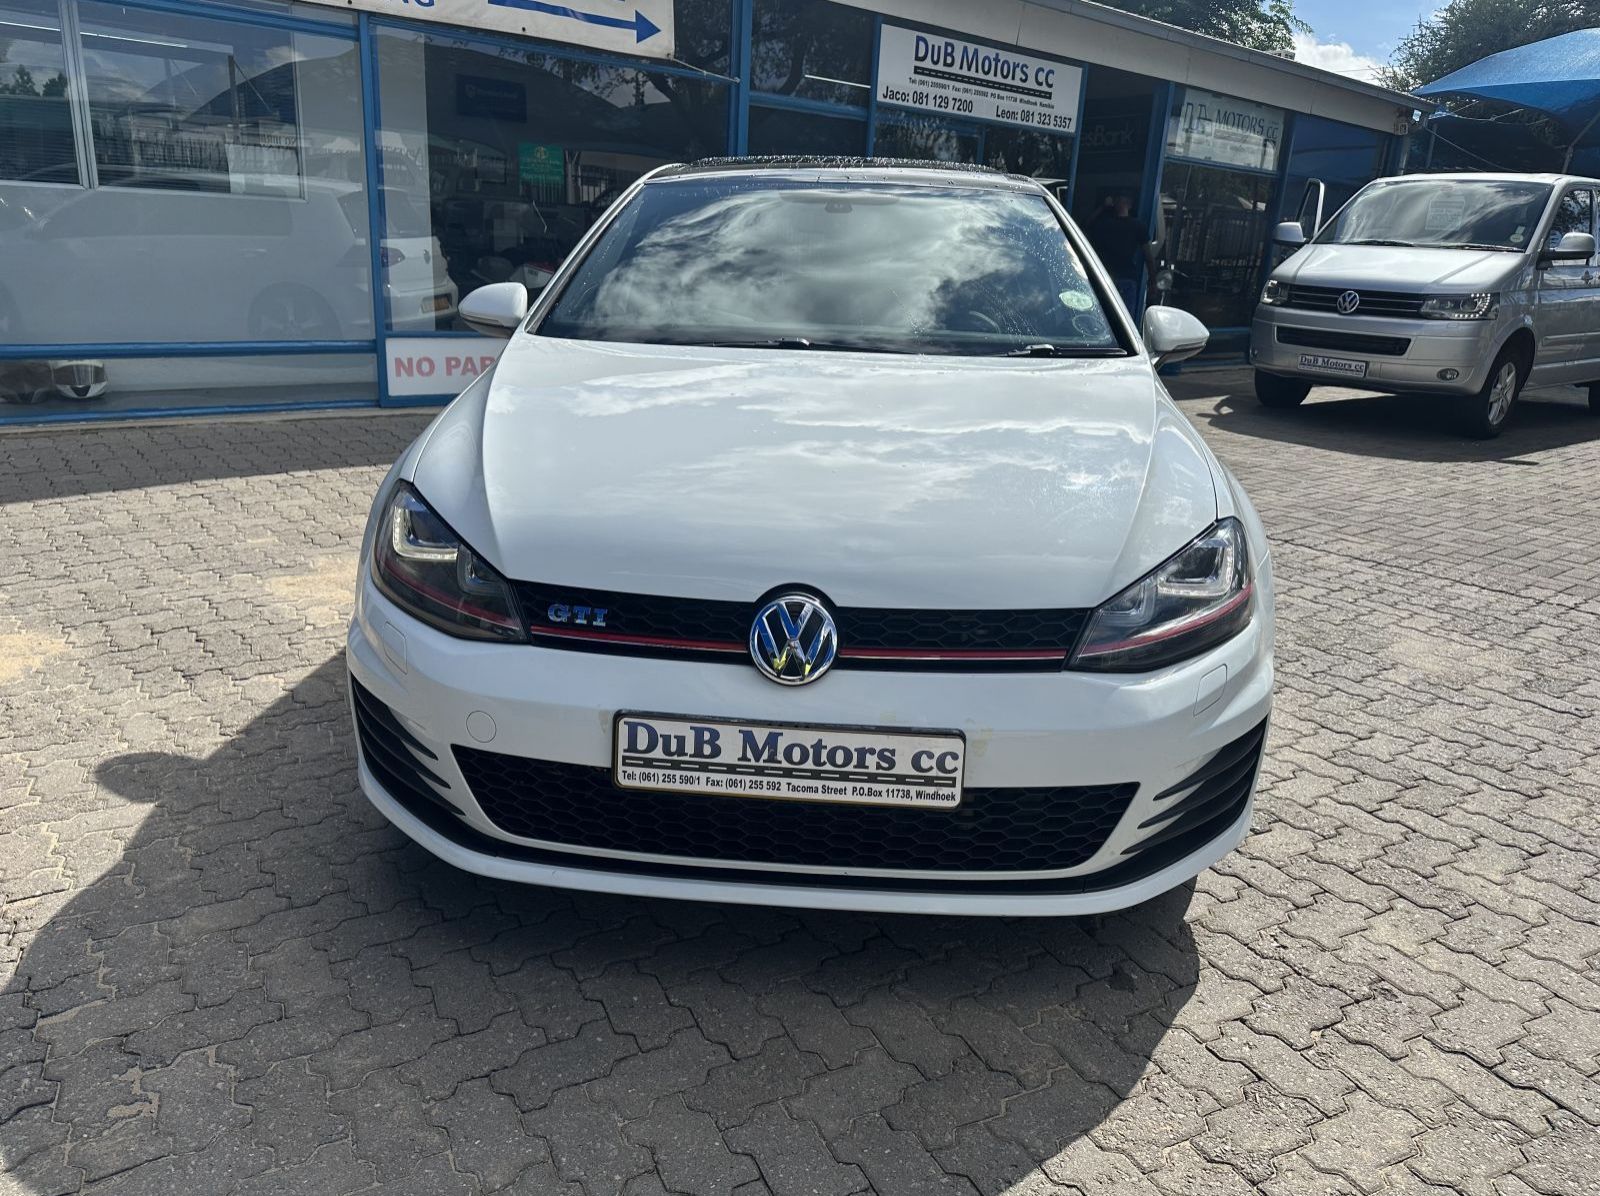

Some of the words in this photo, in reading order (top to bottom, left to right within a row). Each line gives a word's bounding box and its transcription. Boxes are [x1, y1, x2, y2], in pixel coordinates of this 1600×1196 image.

[914, 35, 955, 68] DuB
[959, 46, 1029, 83] Motors
[1034, 67, 1055, 88] cc
[883, 85, 910, 102] Jaco:
[912, 90, 929, 106] 081
[933, 94, 949, 109] 129
[951, 97, 973, 113] 7200
[996, 104, 1018, 121] Leon:
[1020, 109, 1035, 123] 081
[1037, 112, 1052, 126] 323
[1053, 116, 1072, 129] 5357
[1215, 109, 1264, 136] MOTORS
[394, 355, 436, 377] NO
[1300, 355, 1318, 365] DuB
[1321, 357, 1352, 369] Motors
[547, 603, 608, 627] GTI
[623, 721, 722, 760] DuB
[737, 728, 896, 772] Motors
[911, 750, 960, 775] cc
[622, 770, 637, 781] Tel:
[638, 772, 660, 785] (061)
[662, 773, 677, 785] 255
[679, 775, 700, 786] 590/1
[705, 776, 723, 788] Fax:
[725, 778, 747, 791] (061)
[748, 779, 764, 791] 255
[766, 781, 782, 792] 592
[786, 782, 819, 794] Tacoma
[821, 784, 847, 796] Street
[885, 788, 913, 801] 11738,
[915, 789, 956, 802] Windhoek
